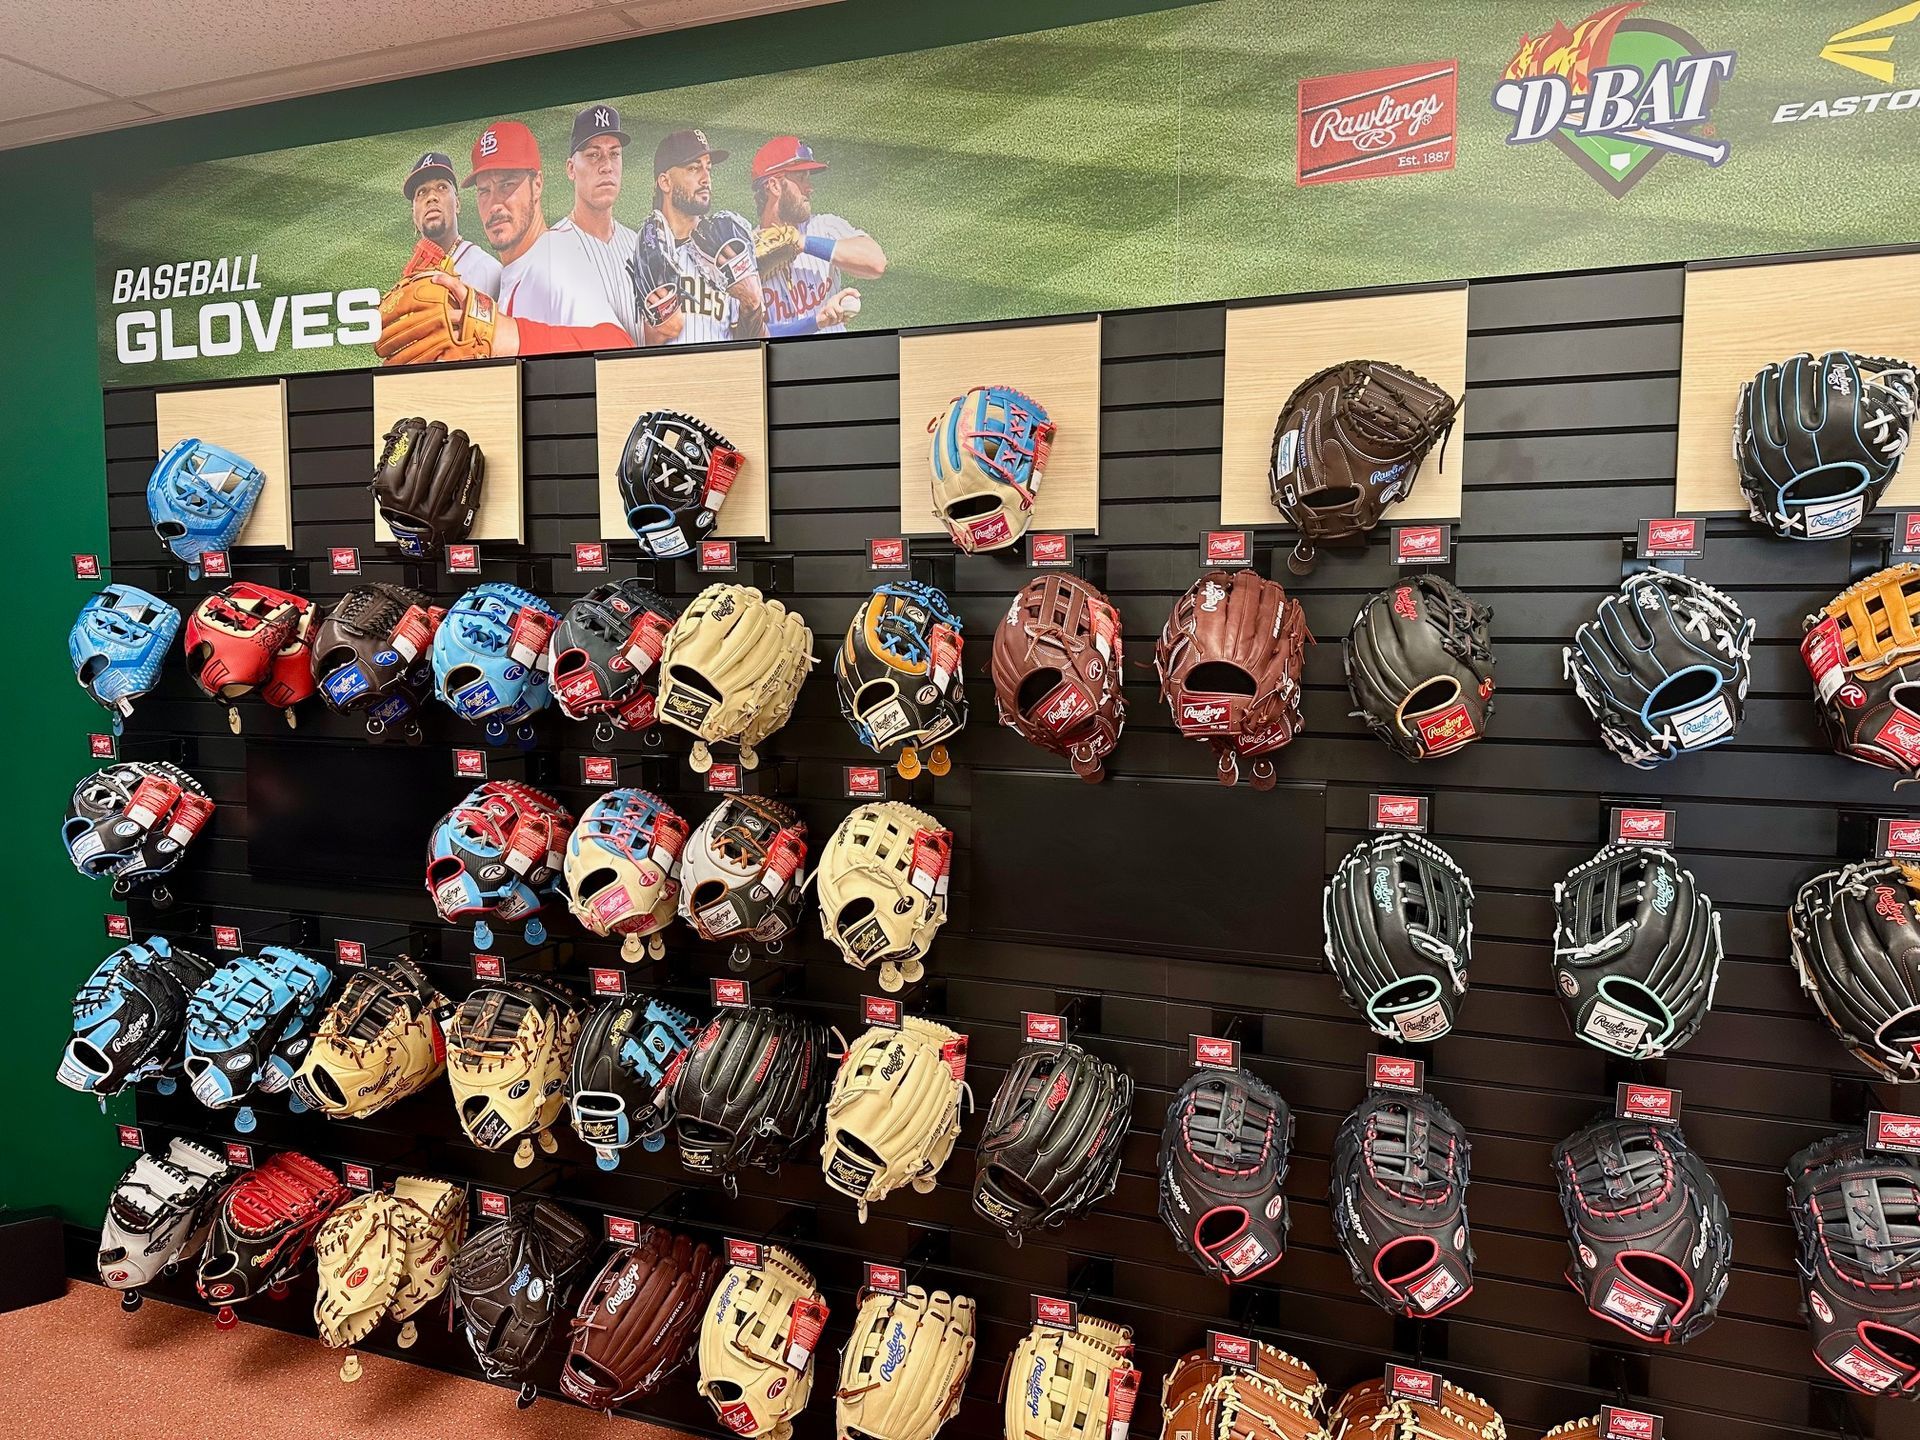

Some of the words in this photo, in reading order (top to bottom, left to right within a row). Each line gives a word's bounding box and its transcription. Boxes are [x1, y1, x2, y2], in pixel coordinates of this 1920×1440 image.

[1510, 54, 1732, 144] D-BAT
[1310, 94, 1444, 149] Rawlings
[1397, 155, 1420, 167] Est.
[1423, 151, 1450, 165] 1887
[112, 254, 262, 304] BASEBALL
[116, 287, 383, 364] GLOVES
[1811, 506, 1857, 528] Rawlings
[1209, 537, 1243, 553] Rawlings
[1402, 534, 1438, 548] Rawlings
[1652, 528, 1690, 542] Rawlings
[703, 546, 730, 560] Rawlings
[874, 544, 900, 559] Rawlings
[1034, 540, 1062, 555] Rawlings
[669, 695, 703, 714] Rawlings
[1184, 705, 1226, 721] Rawlings
[1428, 713, 1465, 739] Rawlings
[1683, 709, 1723, 736] Rawlings
[851, 773, 877, 785] Rawlings
[1382, 802, 1415, 817] Rawlings
[1625, 816, 1663, 833] Rawlings
[1373, 866, 1394, 914] Rawlings
[1652, 865, 1675, 916] Rawlings
[1875, 886, 1908, 926] Rawlings
[868, 1003, 894, 1014] Rawlings
[111, 1013, 149, 1053] Rawlings
[1030, 1021, 1058, 1033] Rawlings
[1404, 1011, 1440, 1033] Rawlings
[1593, 1015, 1639, 1039] Rawlings
[1199, 1044, 1229, 1057] Rawlings
[880, 1043, 905, 1081] Rawlings
[1379, 1063, 1411, 1077] Rawlings
[1631, 1093, 1668, 1107] Rawlings
[833, 1160, 868, 1184] Rawlings
[980, 1192, 1013, 1218] Rawlings
[1230, 1244, 1257, 1269] Rawlings
[606, 1263, 640, 1315] Rawlings
[1420, 1275, 1449, 1304] Rawlings
[1041, 1303, 1067, 1316] Rawlings
[1611, 1293, 1657, 1318] Rawlings
[881, 1321, 908, 1382] Rawlings
[1217, 1340, 1247, 1354] Rawlings
[1397, 1373, 1428, 1389] Rawlings
[1846, 1358, 1891, 1384] Rawlings
[1027, 1355, 1047, 1419] Rawlings
[1614, 1416, 1650, 1431] Rawlings
